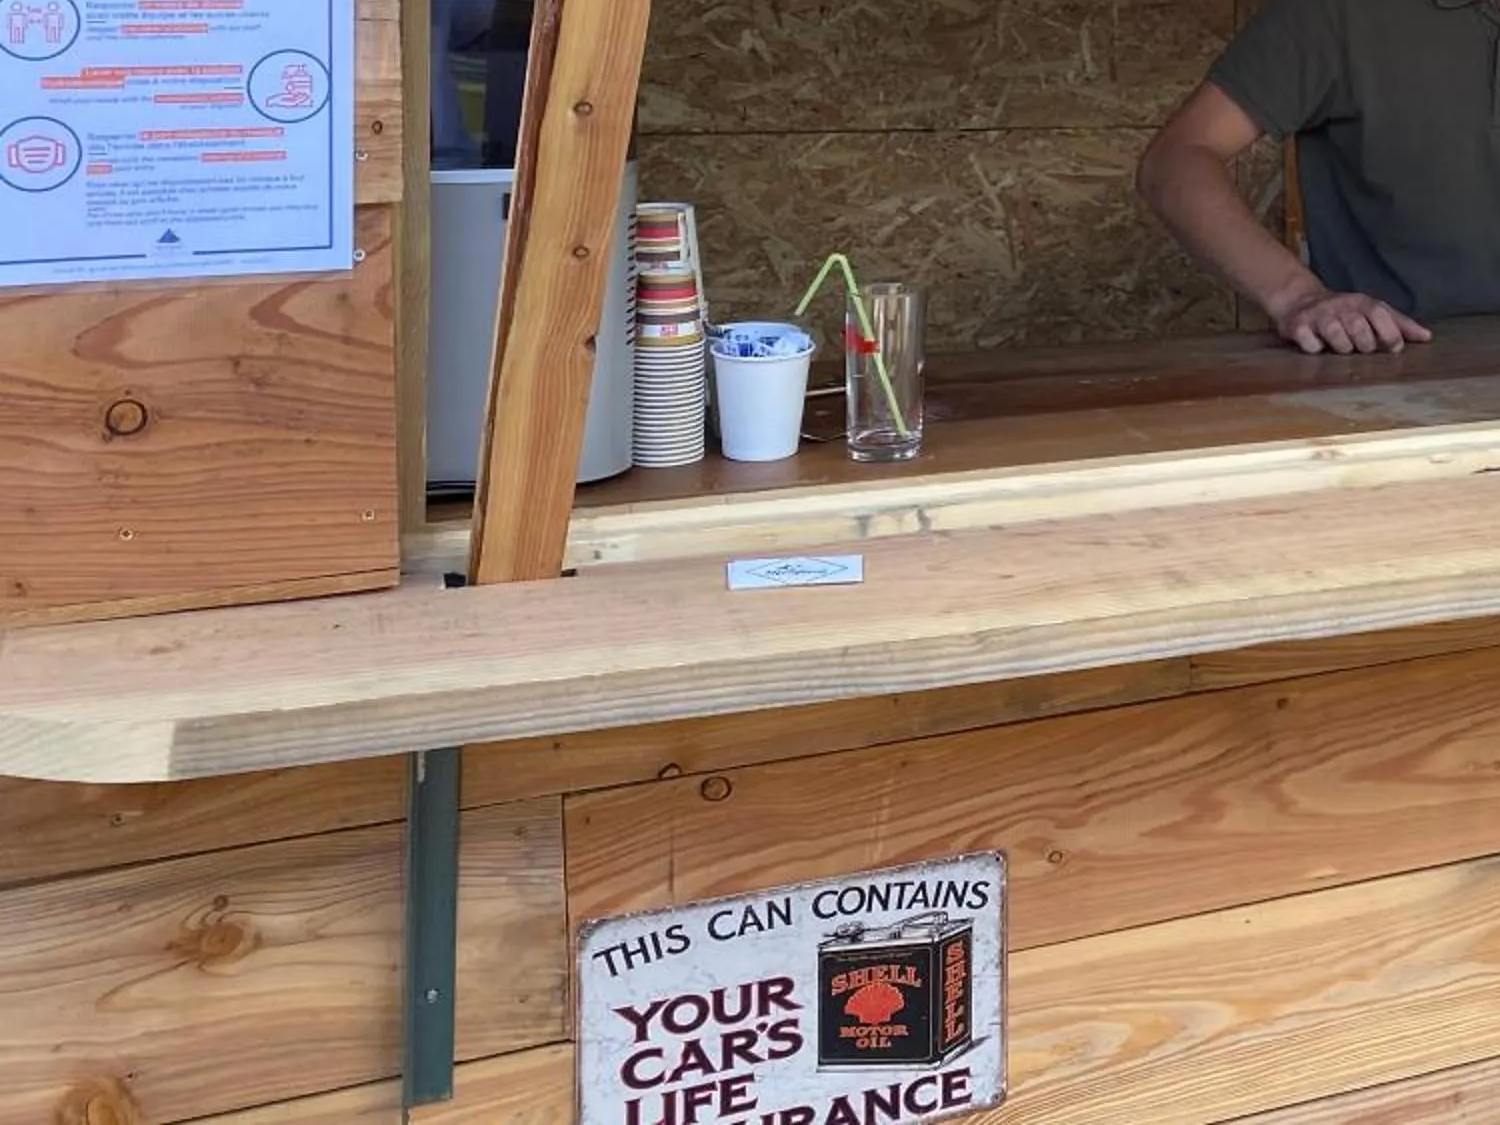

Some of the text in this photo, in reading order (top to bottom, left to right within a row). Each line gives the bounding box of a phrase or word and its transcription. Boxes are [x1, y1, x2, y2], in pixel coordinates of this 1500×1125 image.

[592, 880, 991, 977] THIS CAN CONTAINS
[611, 976, 805, 1043] YOUR
[831, 964, 922, 996] SHELL
[944, 939, 967, 1043] SHELL
[620, 1018, 805, 1090] CAR'S
[839, 1024, 909, 1038] MOTOR
[855, 1036, 892, 1049] OIL
[623, 1073, 759, 1125] LIFE
